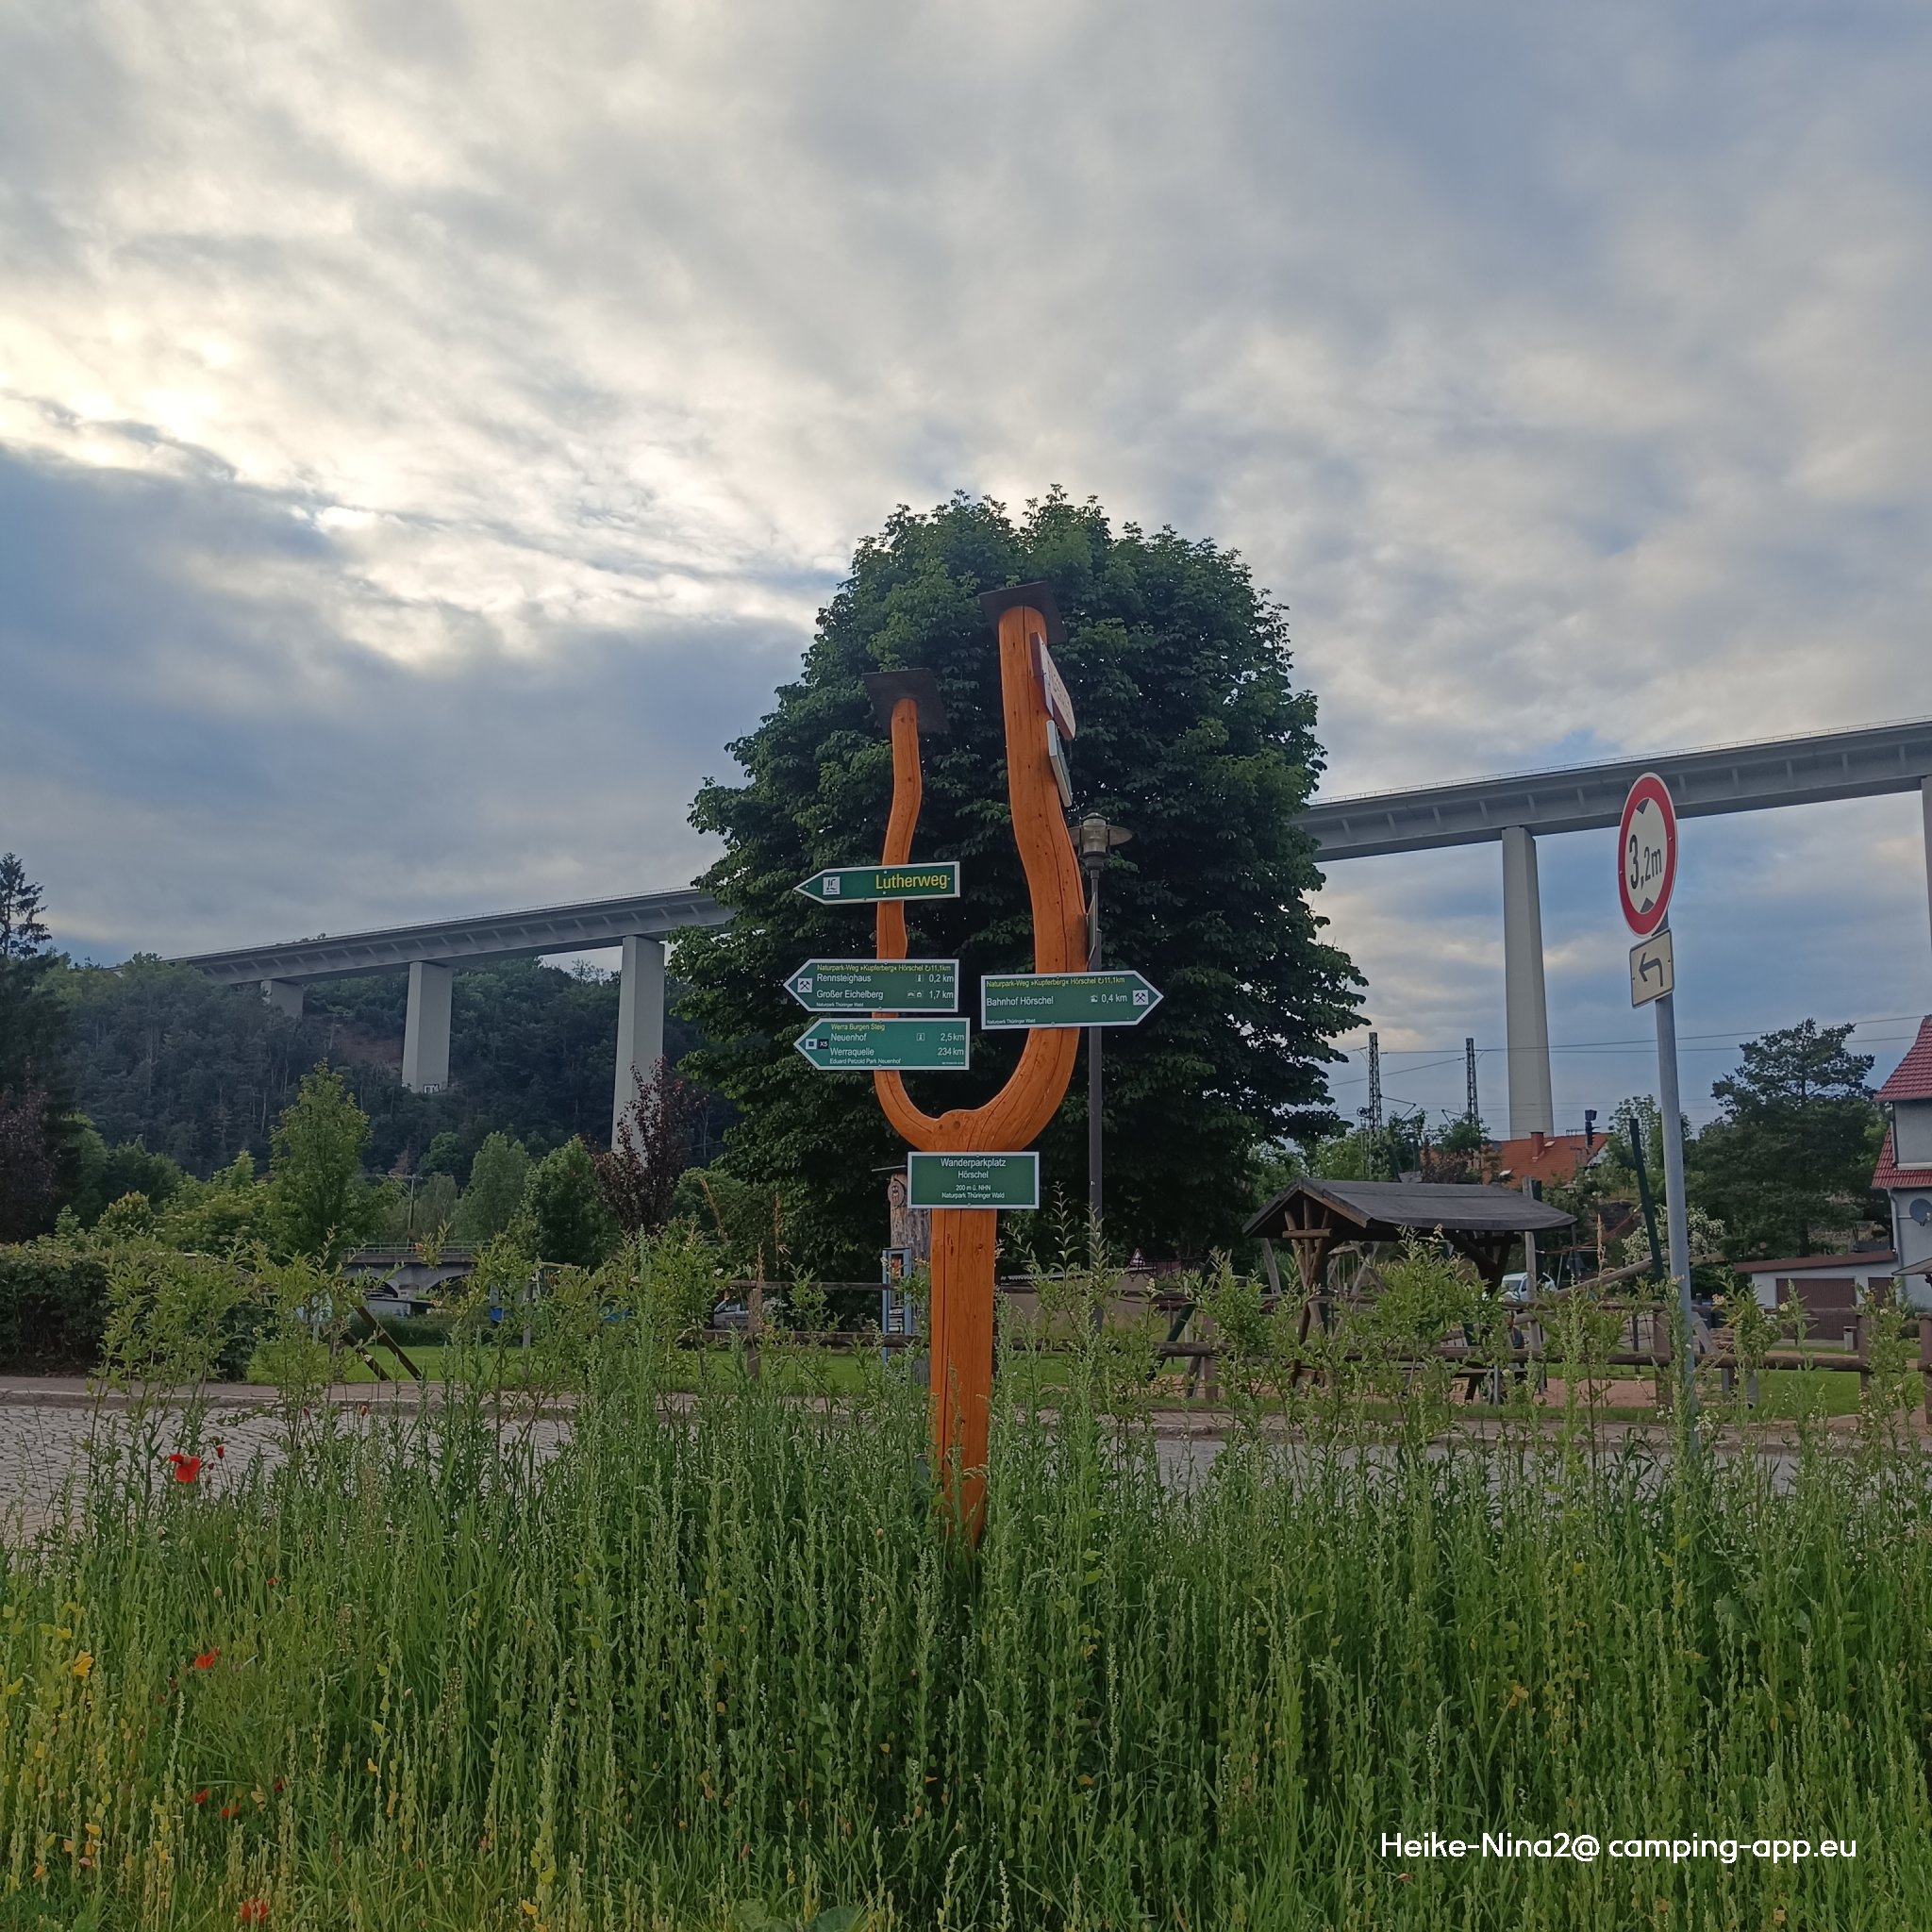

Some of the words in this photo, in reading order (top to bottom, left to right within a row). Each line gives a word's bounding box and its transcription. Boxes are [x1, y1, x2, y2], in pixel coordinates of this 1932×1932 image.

[1629, 834, 1662, 890] 3,2m
[875, 874, 948, 890] Lutherweg
[817, 964, 859, 973] Naturpark-Weg
[816, 974, 872, 983] Rennsteighaus
[928, 974, 941, 983] 0,2
[942, 974, 954, 983] km
[986, 979, 1030, 989] Naturpark-Weg
[816, 990, 843, 999] Großer
[844, 990, 884, 1000] Eichelberg
[929, 991, 941, 1000] 1,7
[941, 991, 954, 999] km
[986, 997, 1019, 1007] Bahnhof
[1020, 995, 1054, 1006] Hörschel
[1101, 993, 1114, 1004] 0,4
[1115, 993, 1127, 1003] km
[849, 1024, 870, 1032] Burgen
[870, 1024, 885, 1032] Steig
[830, 1033, 867, 1041] Neuenhof
[940, 1033, 952, 1042] 2,5
[953, 1033, 965, 1041] km
[830, 1047, 874, 1058] Werraquelle
[938, 1047, 952, 1056] 234
[953, 1047, 964, 1056] km
[941, 1158, 1007, 1168] Wanderparkplatz
[958, 1170, 989, 1179] Hörschel
